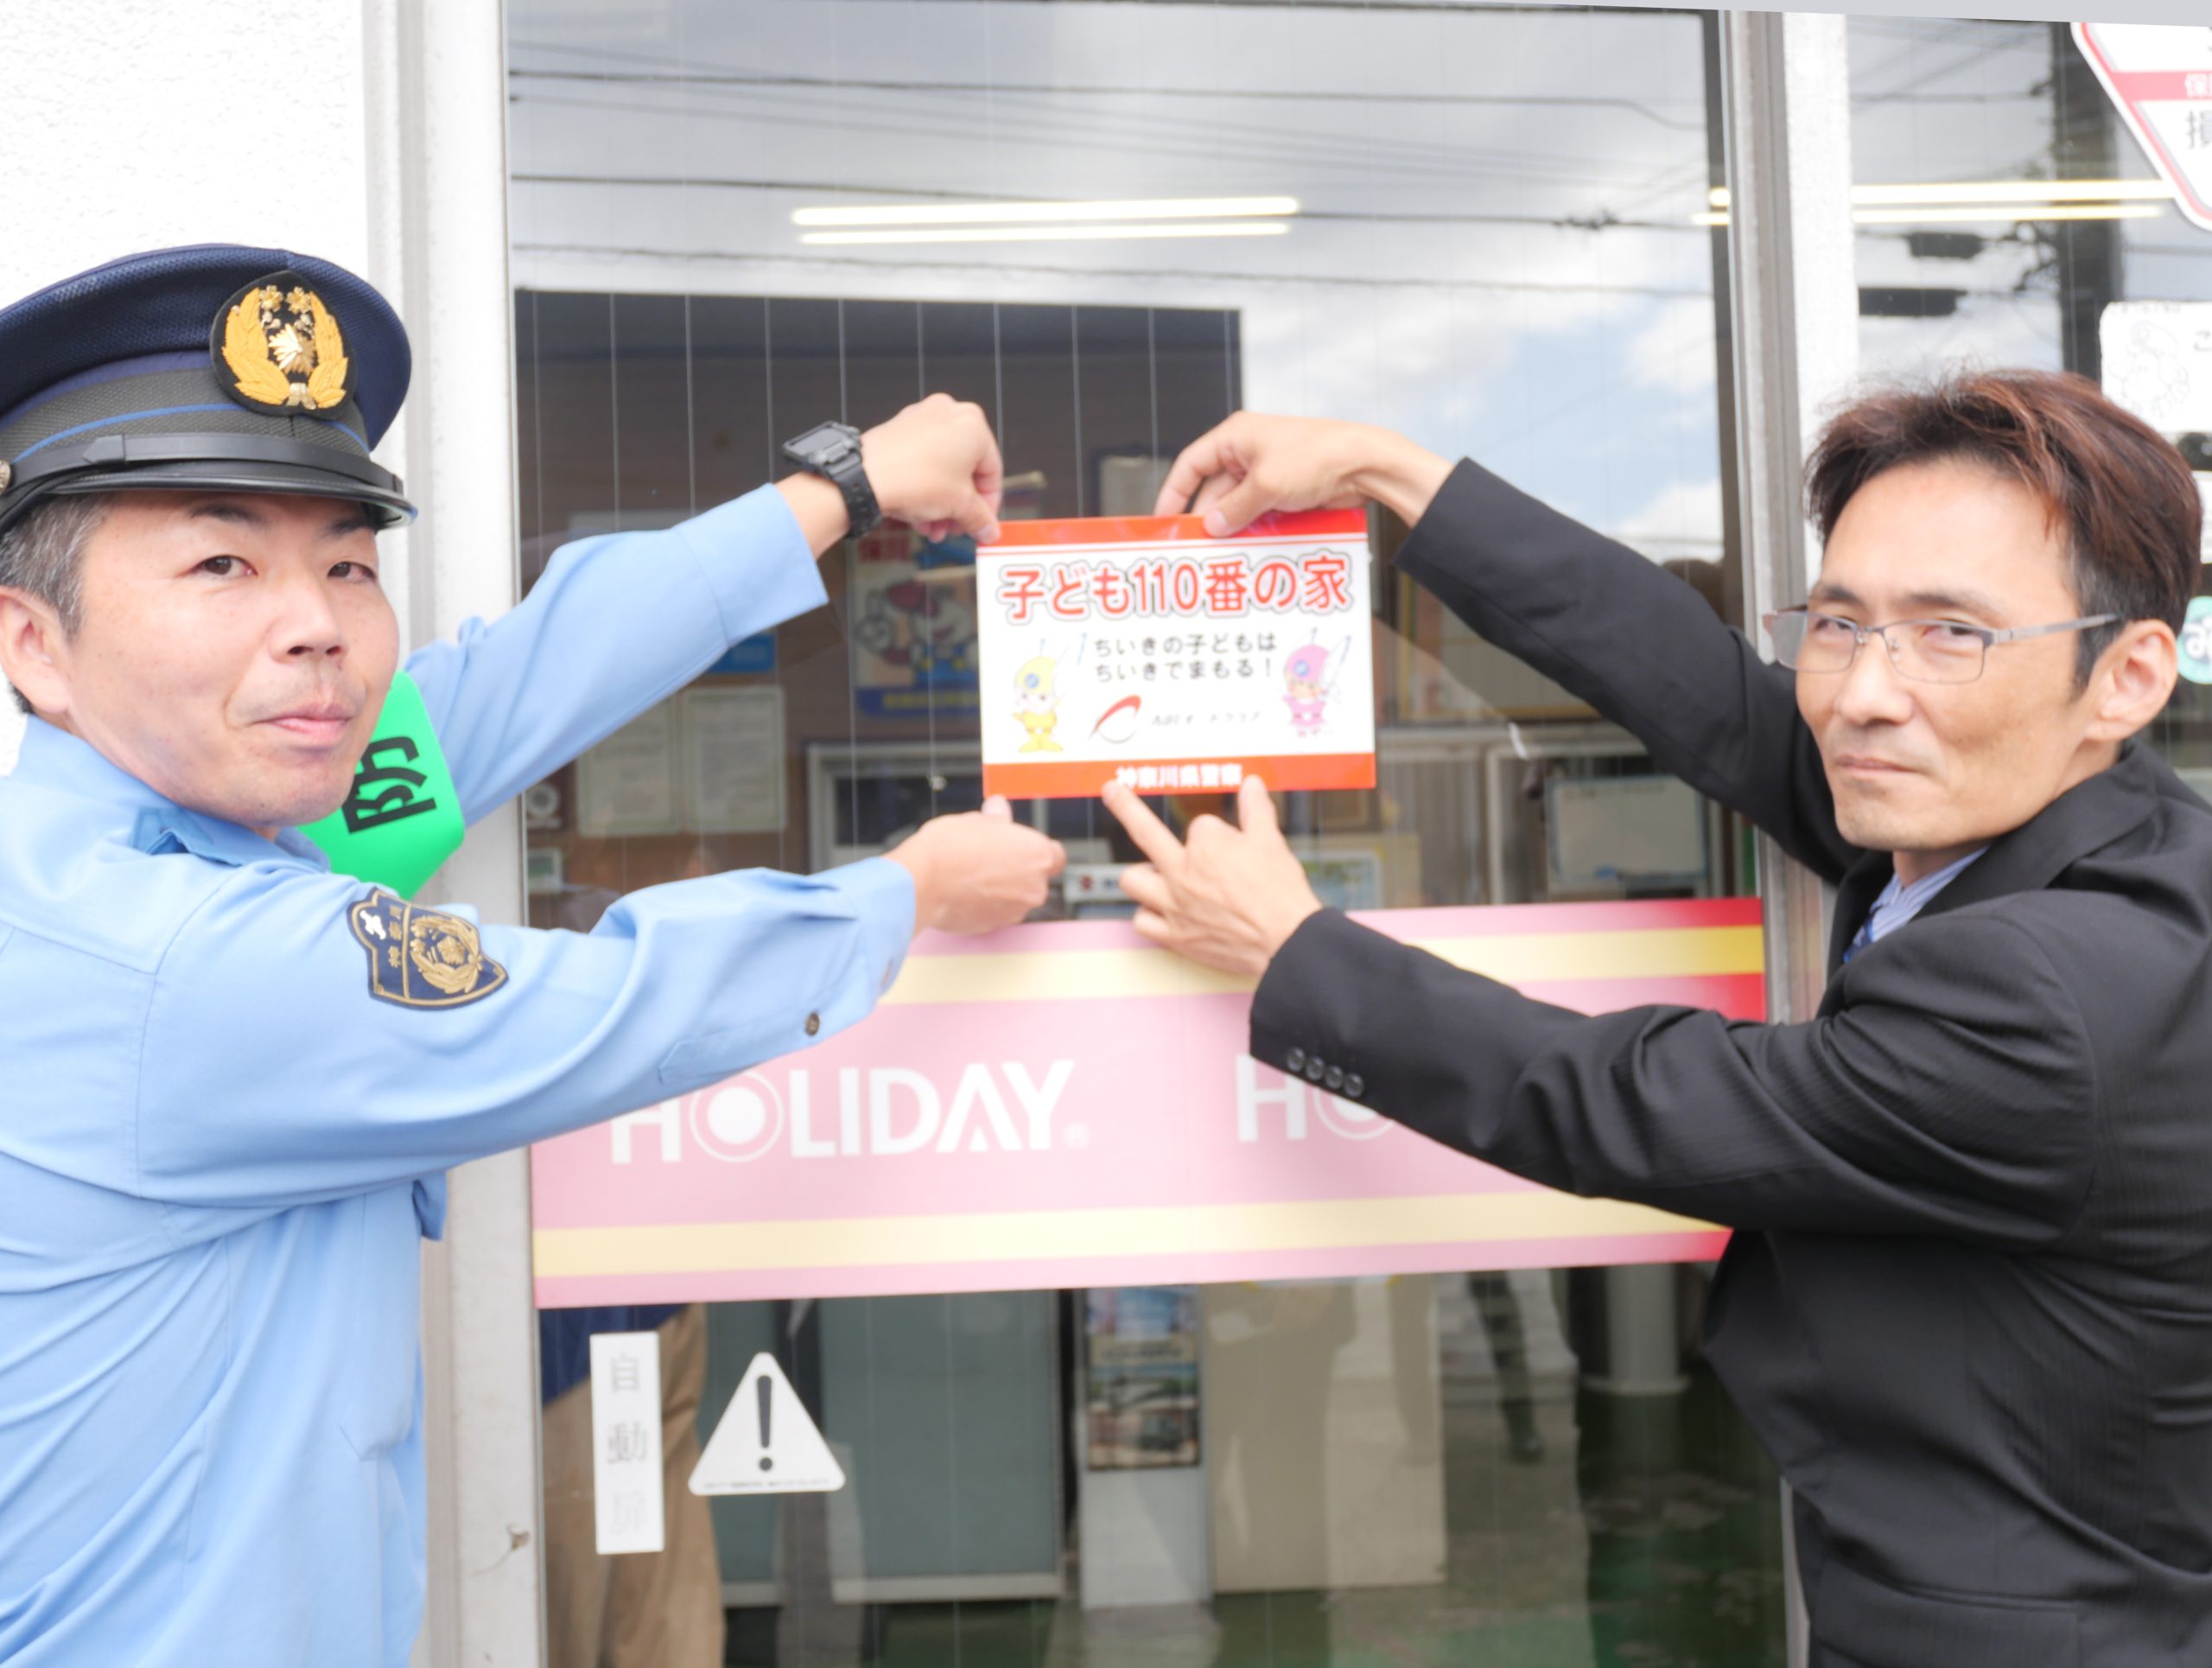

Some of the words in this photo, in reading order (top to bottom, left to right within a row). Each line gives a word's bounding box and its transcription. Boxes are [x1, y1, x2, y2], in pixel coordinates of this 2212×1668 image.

[999, 551, 1351, 622] 子ども110番の家
[1095, 632, 1277, 657] ちいきの子どもは
[611, 1060, 1076, 1165] HOLIDAY
